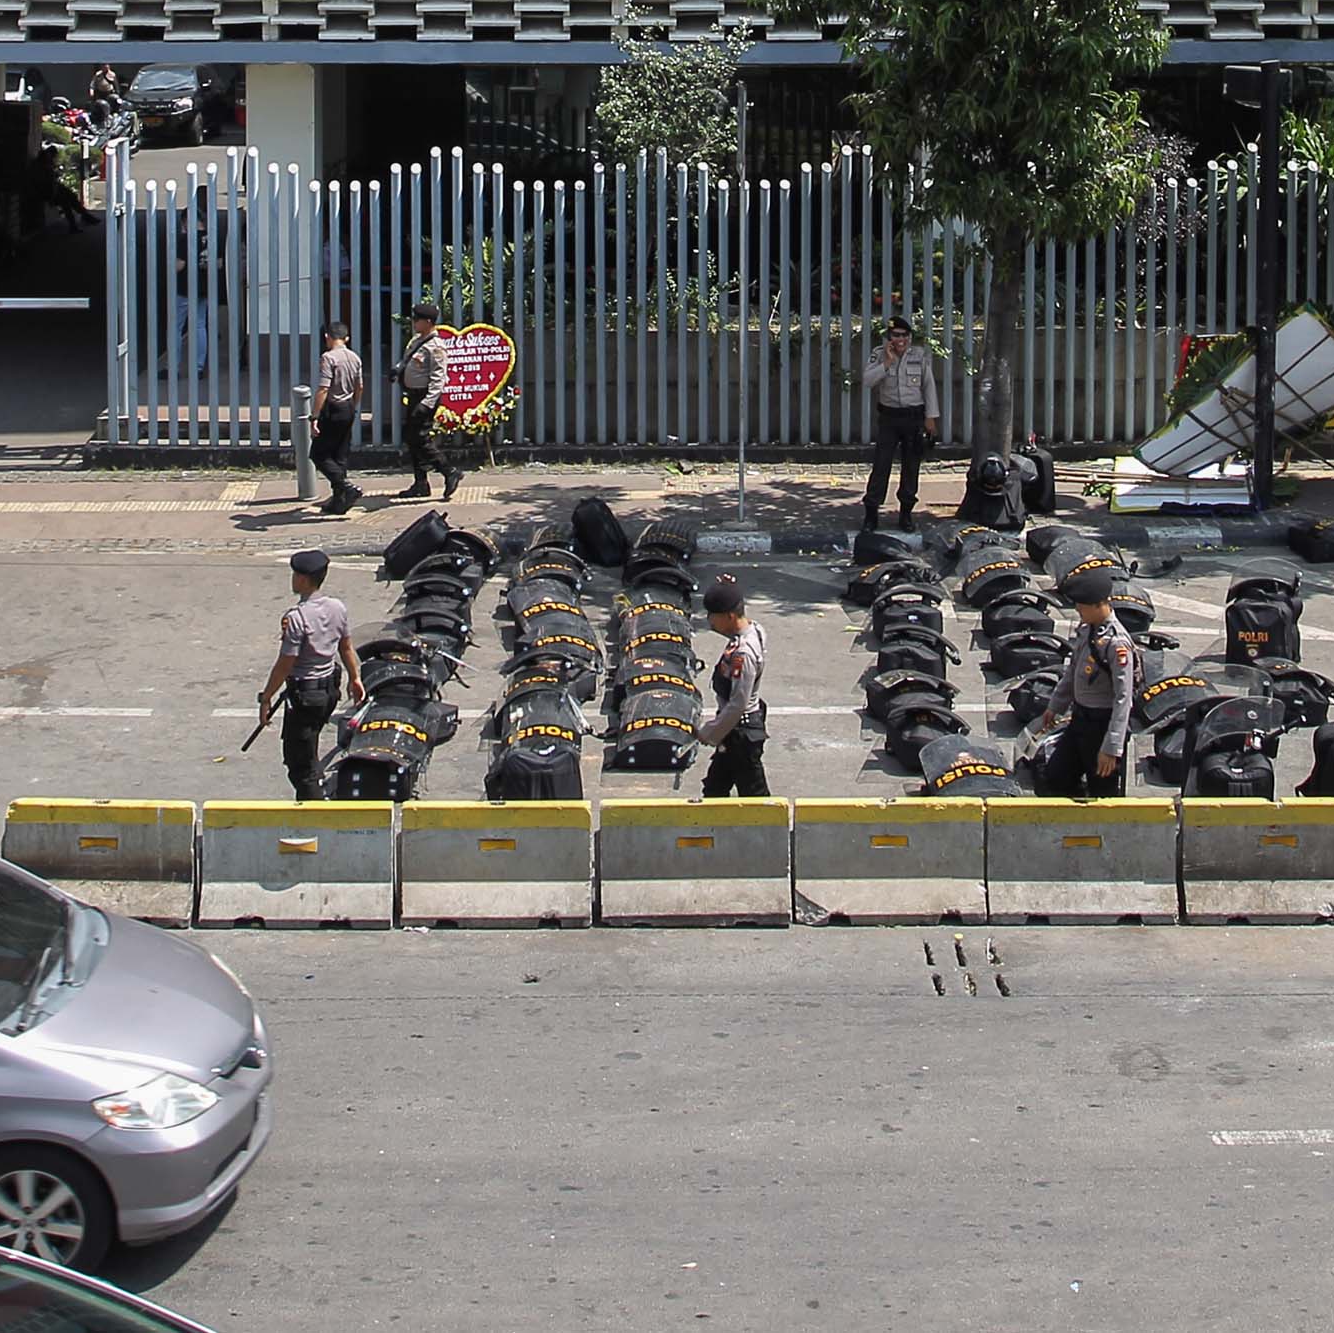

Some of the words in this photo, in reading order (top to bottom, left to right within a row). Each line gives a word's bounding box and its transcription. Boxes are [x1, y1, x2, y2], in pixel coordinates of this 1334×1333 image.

[523, 601, 582, 618] POLISI
[537, 634, 597, 652] POLISI
[624, 631, 684, 652] POLISI
[1238, 630, 1269, 643] POLRI
[633, 673, 695, 692] POLISI
[1141, 675, 1207, 702] POLISI
[361, 719, 429, 743] POLISI
[507, 724, 575, 745] POLISI
[627, 717, 694, 736] POLISI
[935, 764, 1008, 789] POLISI
